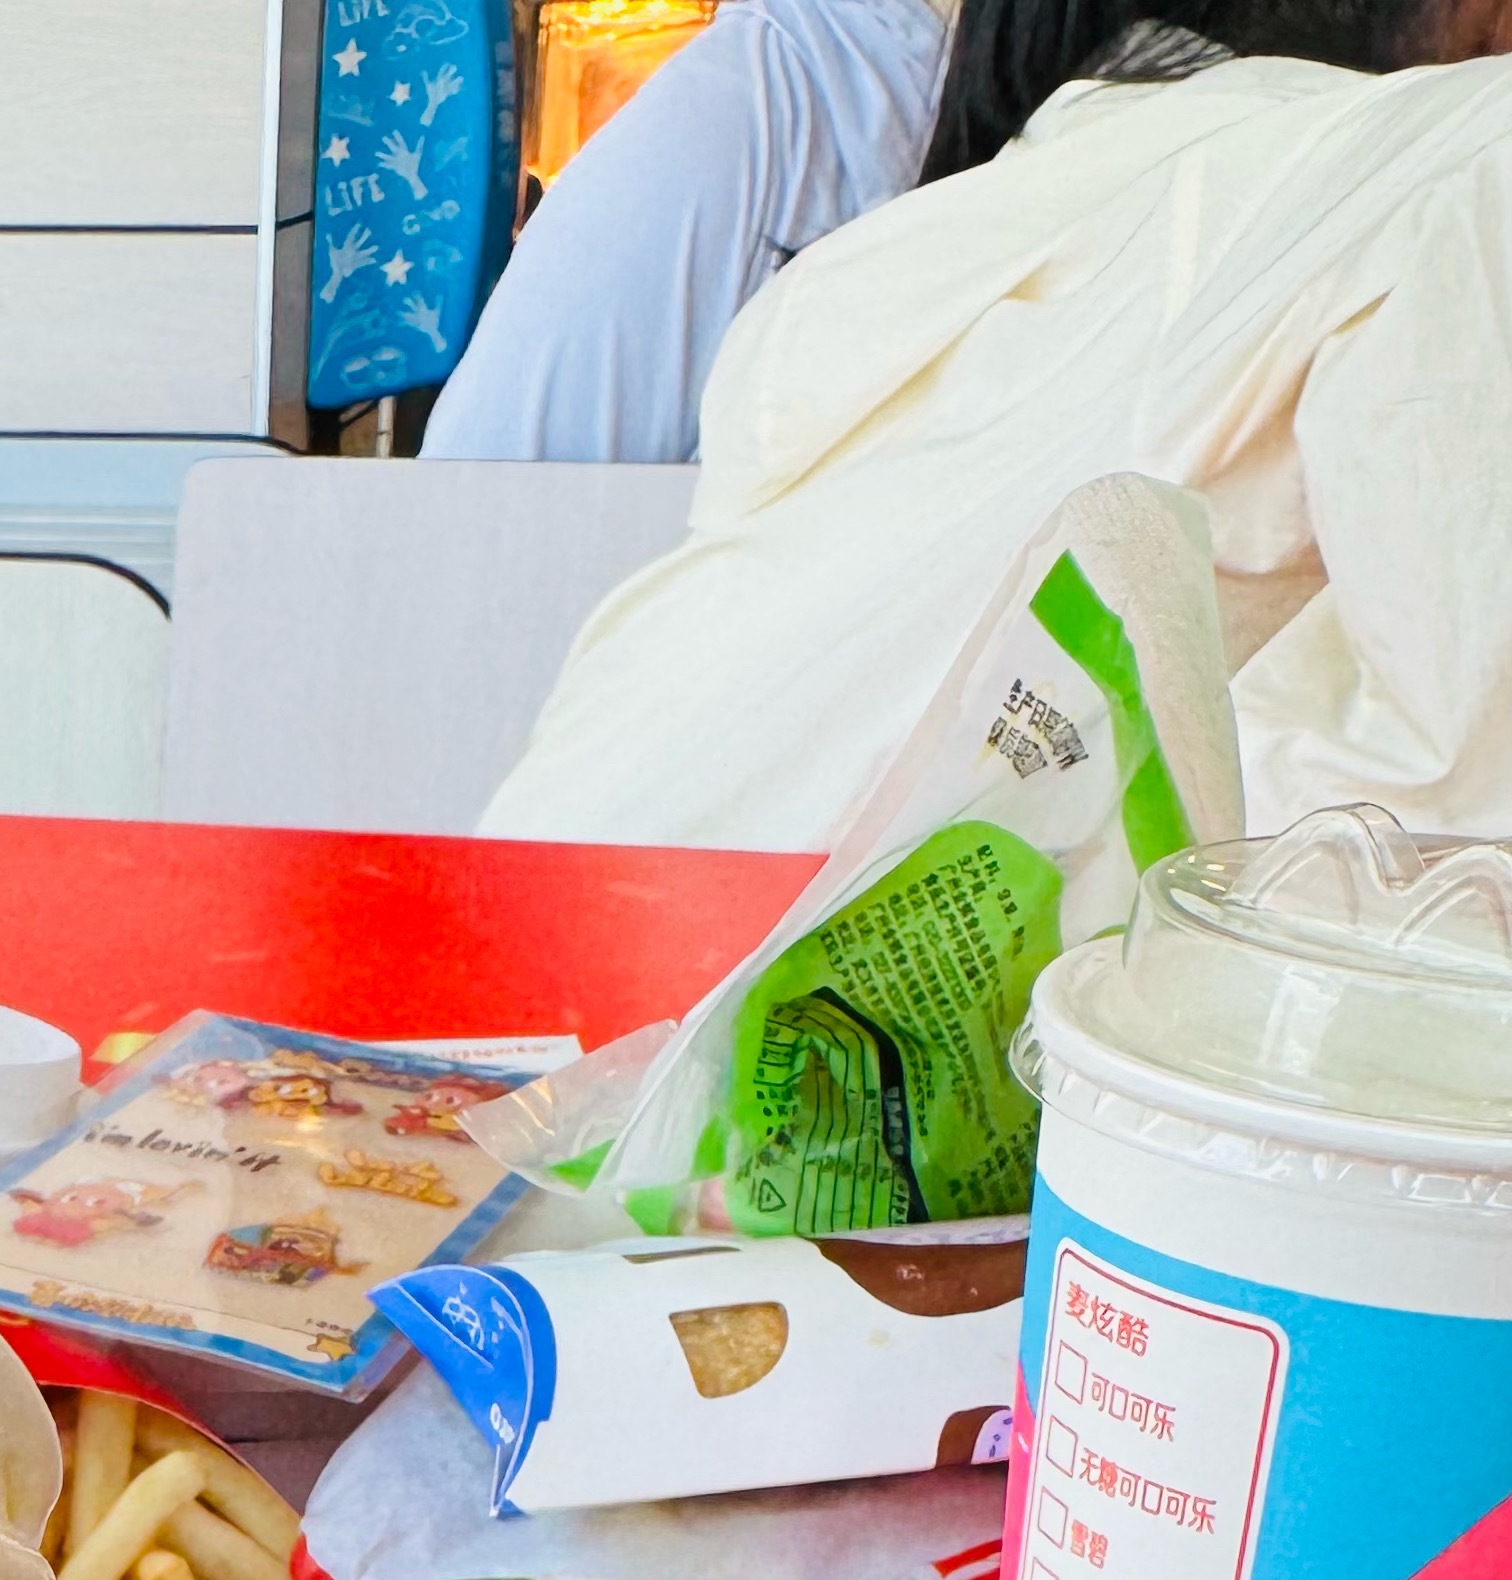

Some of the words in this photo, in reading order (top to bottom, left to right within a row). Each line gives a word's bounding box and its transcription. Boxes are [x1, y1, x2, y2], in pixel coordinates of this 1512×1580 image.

[1065, 1281, 1149, 1357] 麦炫酷
[1091, 1372, 1177, 1442] 可口可乐
[1079, 1447, 1217, 1534] 无糖可口可乐
[1070, 1518, 1109, 1569] 雪碧
